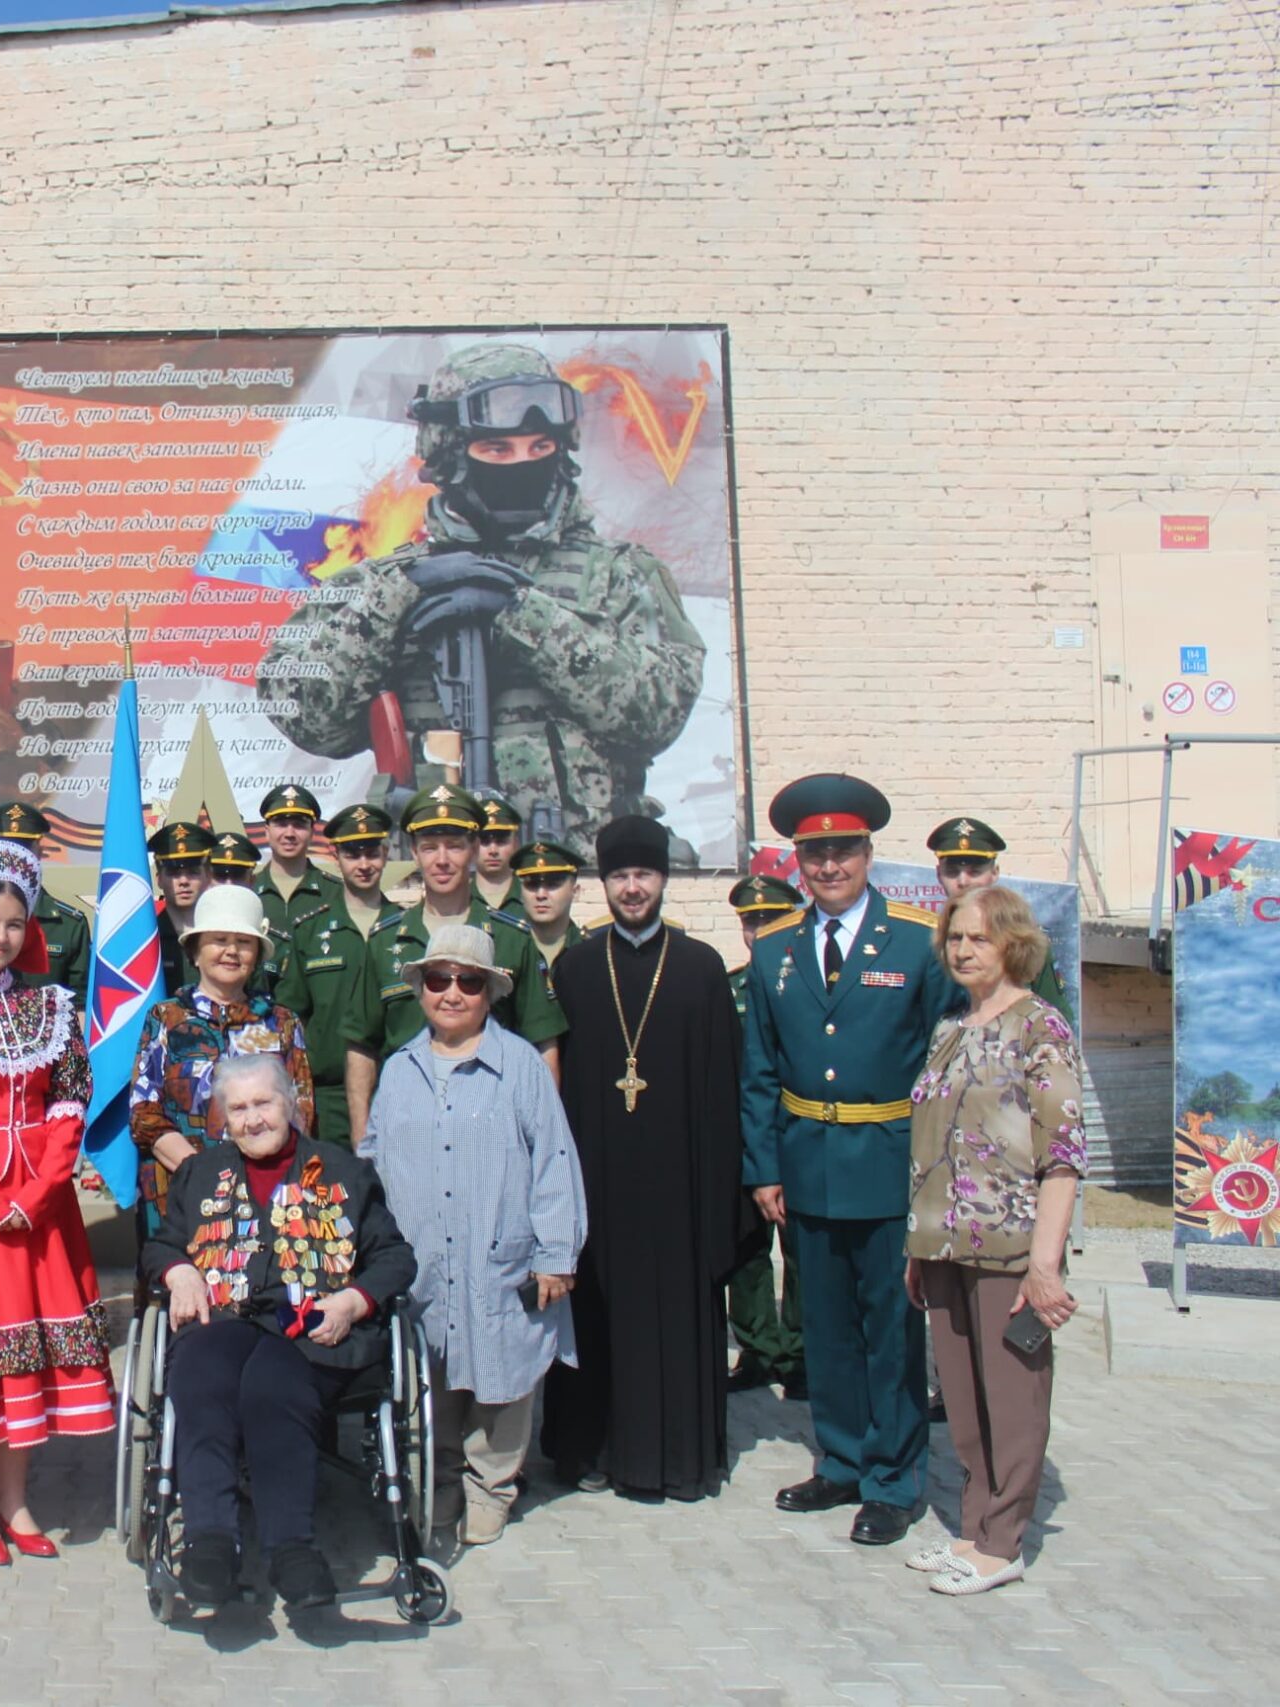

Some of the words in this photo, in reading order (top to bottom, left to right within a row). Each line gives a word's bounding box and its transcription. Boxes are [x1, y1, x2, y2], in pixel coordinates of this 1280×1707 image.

[17, 367, 110, 392] Чествуем
[116, 365, 208, 388] погибших
[209, 369, 220, 384] и
[16, 405, 68, 424] Тех,
[76, 408, 113, 426] кто
[118, 408, 153, 422] пал,
[161, 403, 245, 424] Отчизну
[250, 404, 338, 421] защищая,
[16, 441, 80, 460] Имена
[86, 444, 140, 461] навек
[142, 443, 237, 457] запомним
[243, 442, 274, 458] их,
[17, 478, 81, 498] Жизнь
[86, 481, 120, 494] они
[125, 480, 169, 494] свою
[173, 479, 193, 493] за
[199, 478, 229, 492] нас
[234, 473, 307, 492] отдали.
[18, 515, 34, 534] С
[37, 511, 116, 536] каждым
[120, 511, 175, 531] годом
[180, 517, 208, 529] все
[212, 516, 275, 534] короче
[275, 509, 313, 534] ряд
[19, 548, 113, 571] Очевидцев
[119, 553, 156, 571] тех
[158, 547, 196, 566] боев
[201, 551, 297, 571] кровавых,
[17, 588, 80, 611] Пусть
[84, 591, 112, 608] же
[115, 590, 186, 610] взрывы
[191, 583, 258, 603] больше
[262, 589, 284, 602] не
[17, 624, 46, 643] Не
[152, 622, 260, 646] застарелой
[262, 621, 323, 645] раны!
[20, 663, 61, 680] Ваш
[64, 662, 160, 687] геройсий
[165, 657, 226, 678] подвиг
[231, 663, 253, 677] не
[256, 655, 332, 679] забыть,
[17, 697, 83, 723] Пусть
[86, 695, 118, 717] год
[17, 735, 50, 756] Но
[230, 737, 287, 755] кисть
[20, 773, 39, 793] В
[40, 773, 96, 797] Вашу
[233, 771, 343, 789] неопалимо!
